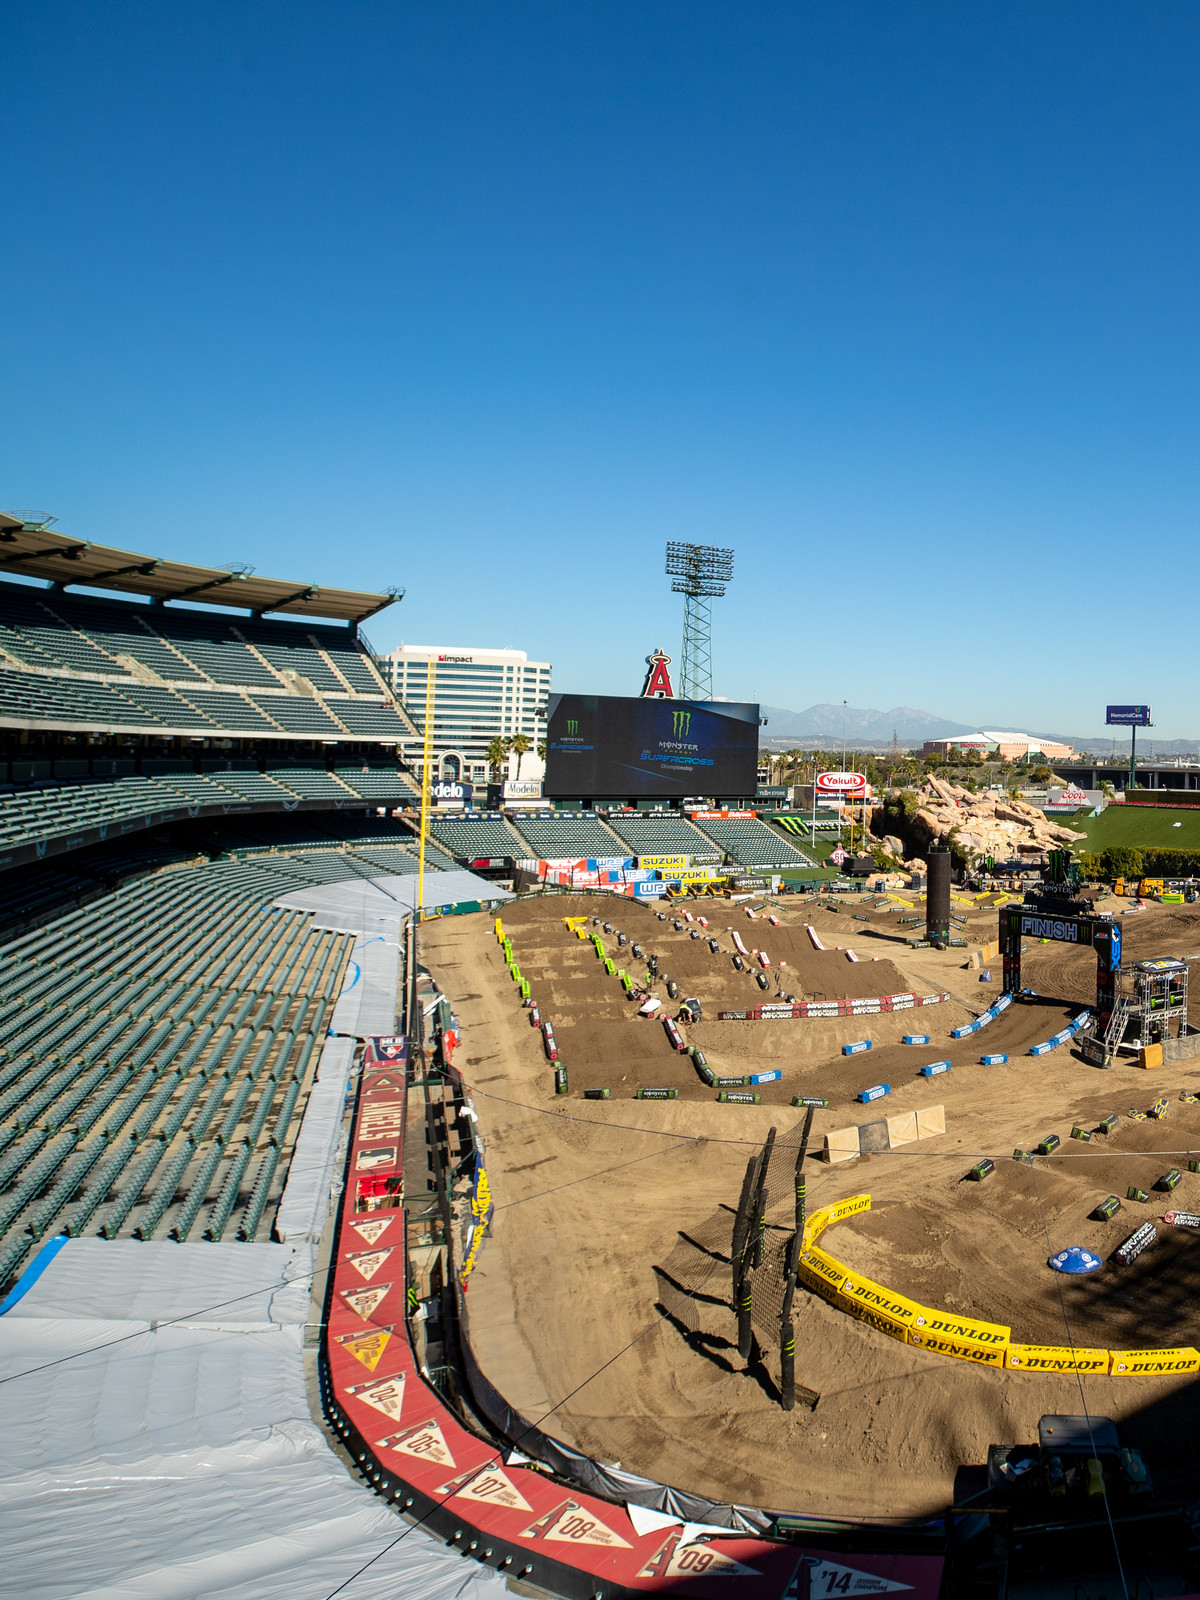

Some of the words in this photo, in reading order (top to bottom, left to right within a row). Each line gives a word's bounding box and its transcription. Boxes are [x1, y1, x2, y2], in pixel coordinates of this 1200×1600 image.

[445, 654, 473, 663] impact
[658, 741, 699, 750] MONSTER
[640, 753, 715, 766] SUPERCROSS
[509, 783, 537, 794] Modelo
[826, 777, 859, 785] Yakult
[1061, 789, 1087, 800] Coors
[643, 857, 684, 865] SUZUKI
[664, 871, 706, 879] SUZUKI
[641, 884, 667, 893] WP
[1038, 883, 1074, 895] MONSTER
[1021, 916, 1078, 942] FINISH
[358, 1101, 401, 1141] ANGELS
[837, 1198, 870, 1218] DUNLOP
[808, 1256, 843, 1282] DUNLOP
[854, 1286, 913, 1319] DUNLOP
[849, 1300, 904, 1335] DUNLOP
[928, 1320, 1005, 1345] DUNLOP
[924, 1338, 998, 1363] DUNLOP
[1024, 1358, 1104, 1371] DUNLOP
[1129, 1359, 1197, 1373] DUNLOP
[368, 1384, 399, 1405] '04
[406, 1432, 441, 1454] '05
[471, 1476, 507, 1498] '07
[558, 1515, 596, 1540] '08
[677, 1549, 715, 1573] '09
[821, 1570, 853, 1594] '14
